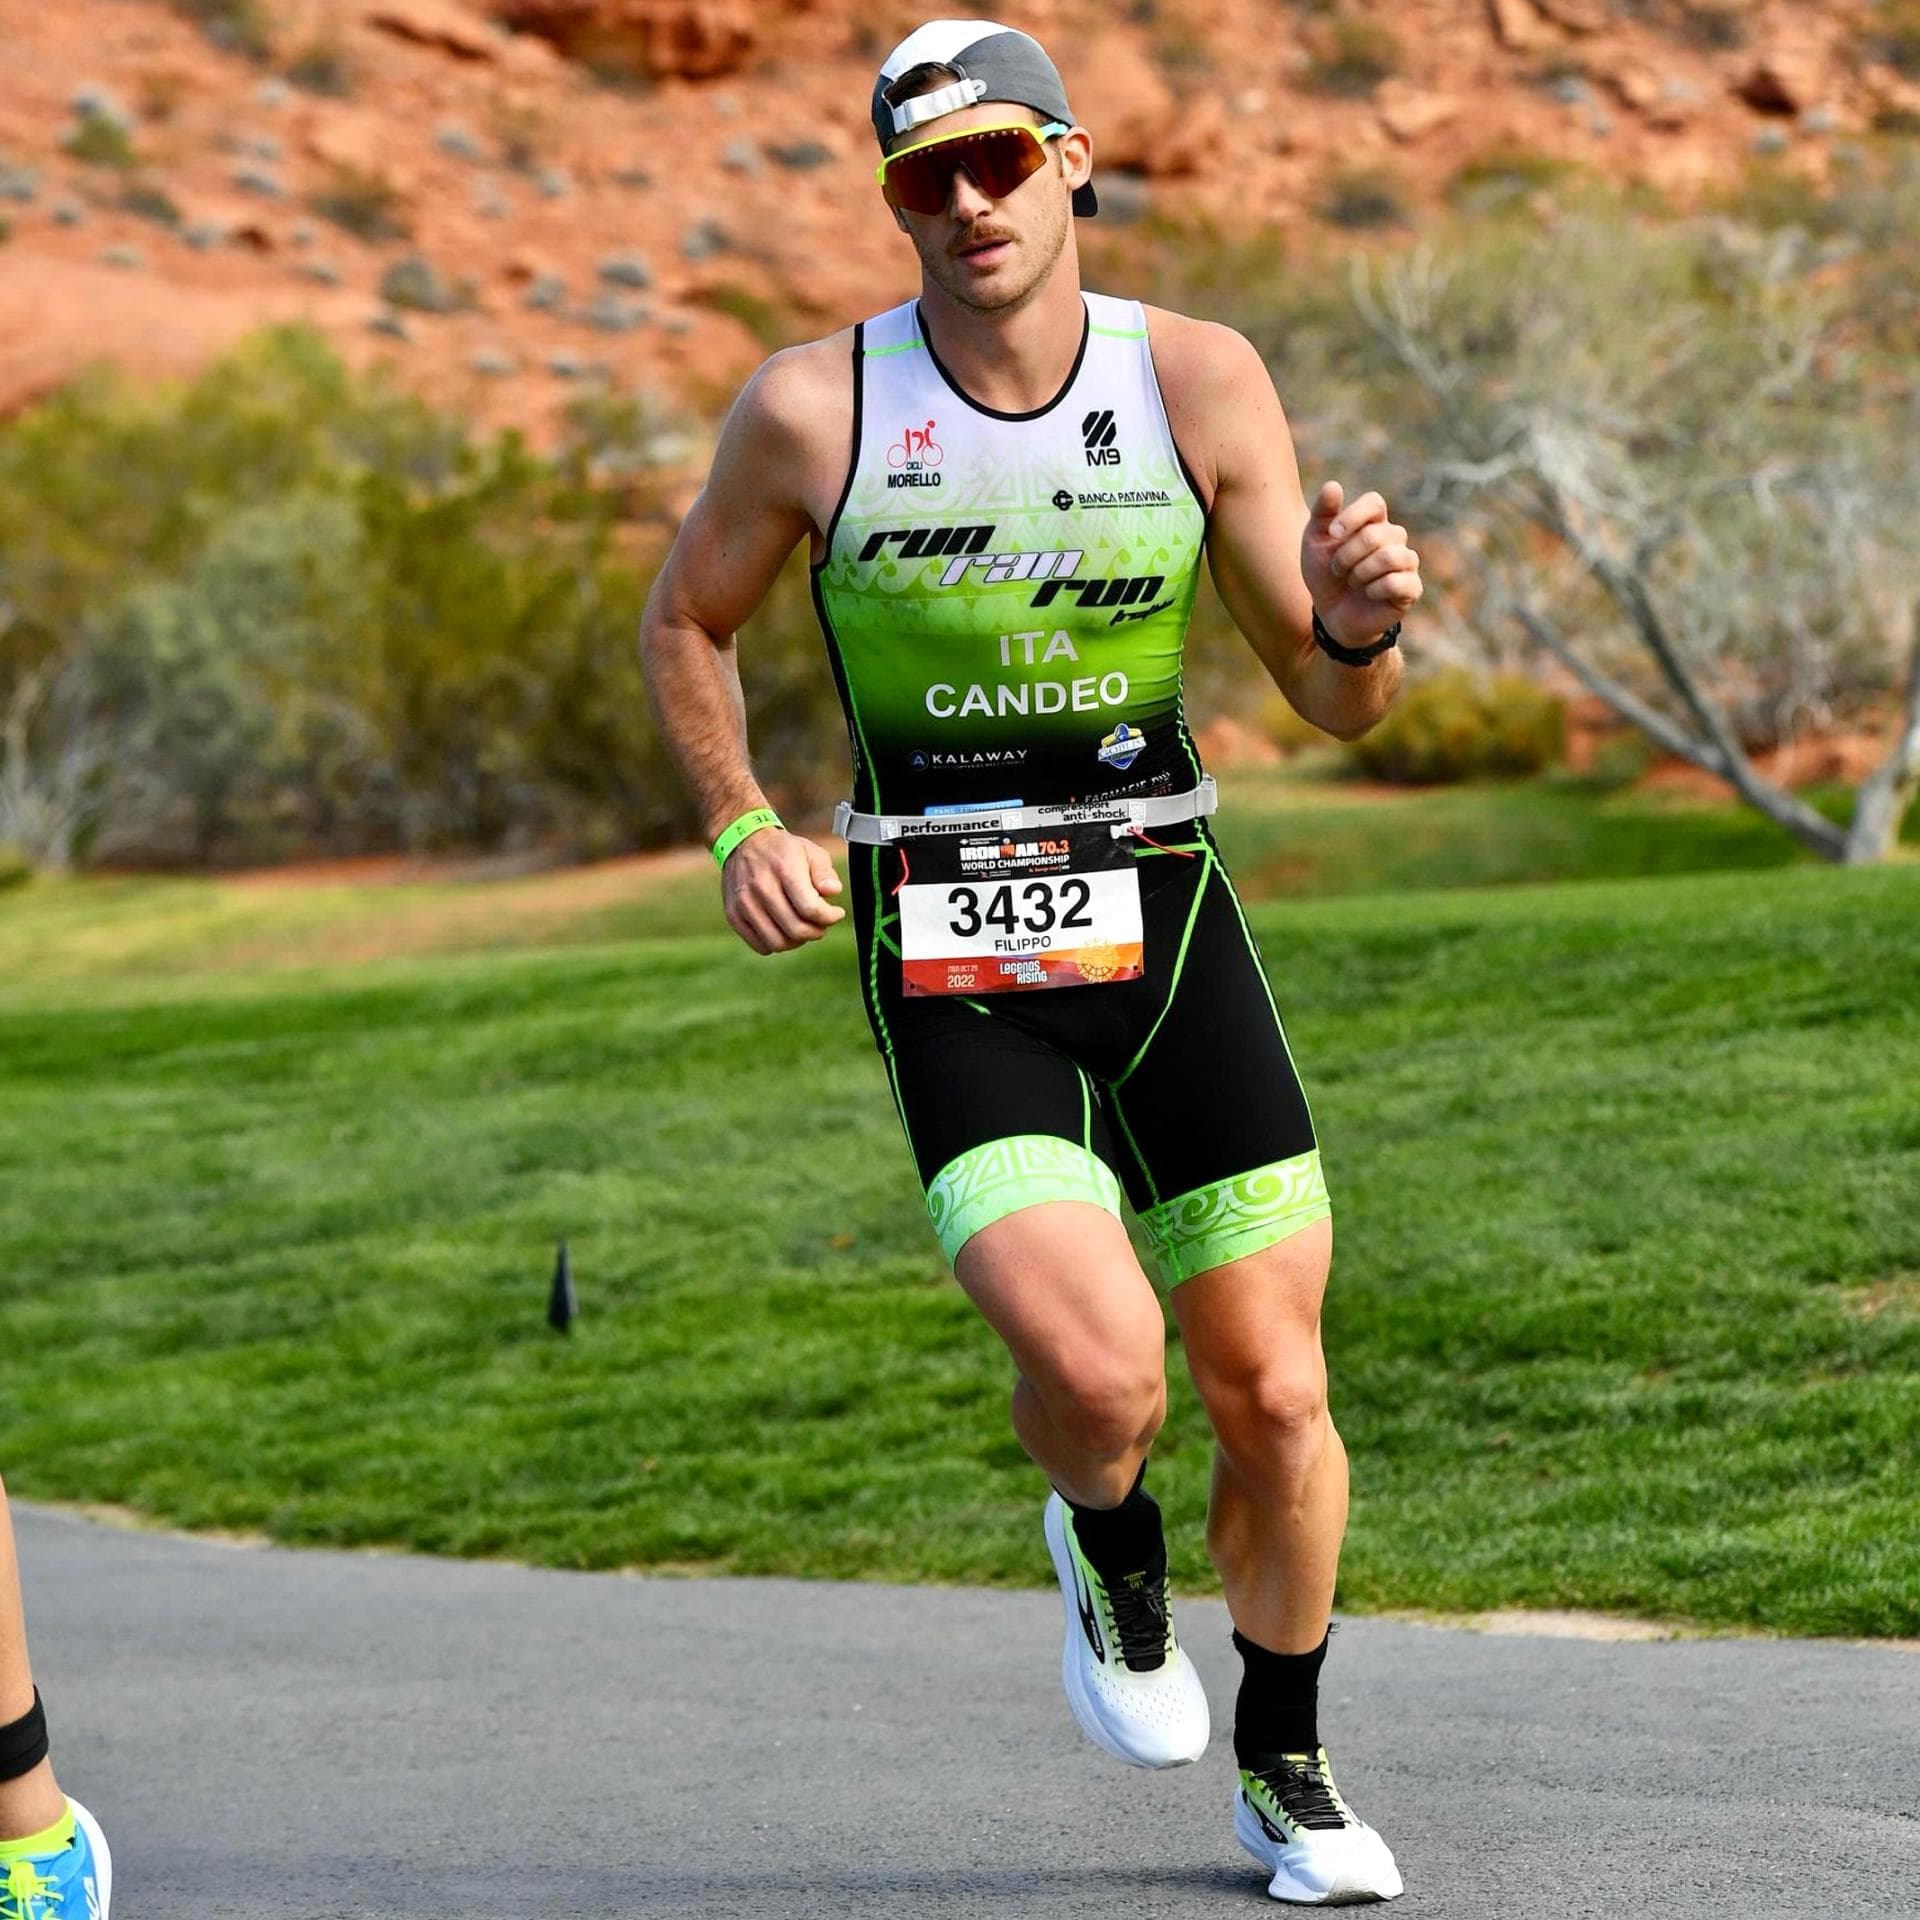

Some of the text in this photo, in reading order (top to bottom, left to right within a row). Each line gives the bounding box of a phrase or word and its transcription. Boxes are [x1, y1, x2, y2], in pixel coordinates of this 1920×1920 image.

[1086, 448, 1121, 466] M9
[887, 472, 941, 488] MORELLO
[1078, 491, 1170, 504] BANCA PATAVINA
[857, 525, 996, 562] run
[939, 549, 1084, 586] ran
[1030, 576, 1165, 607] run
[999, 630, 1079, 667] ITA
[925, 671, 1129, 718] CANDEO
[932, 749, 1028, 764] KALAWAY
[1038, 801, 1110, 815] compressport
[1063, 808, 1126, 823] anti-shock
[901, 818, 1000, 836] performance
[961, 855, 1070, 872] WORLD CHAMPIONSHIP
[947, 879, 1093, 938] 3432
[995, 936, 1052, 952] FILIPPO
[947, 974, 976, 989] 2022
